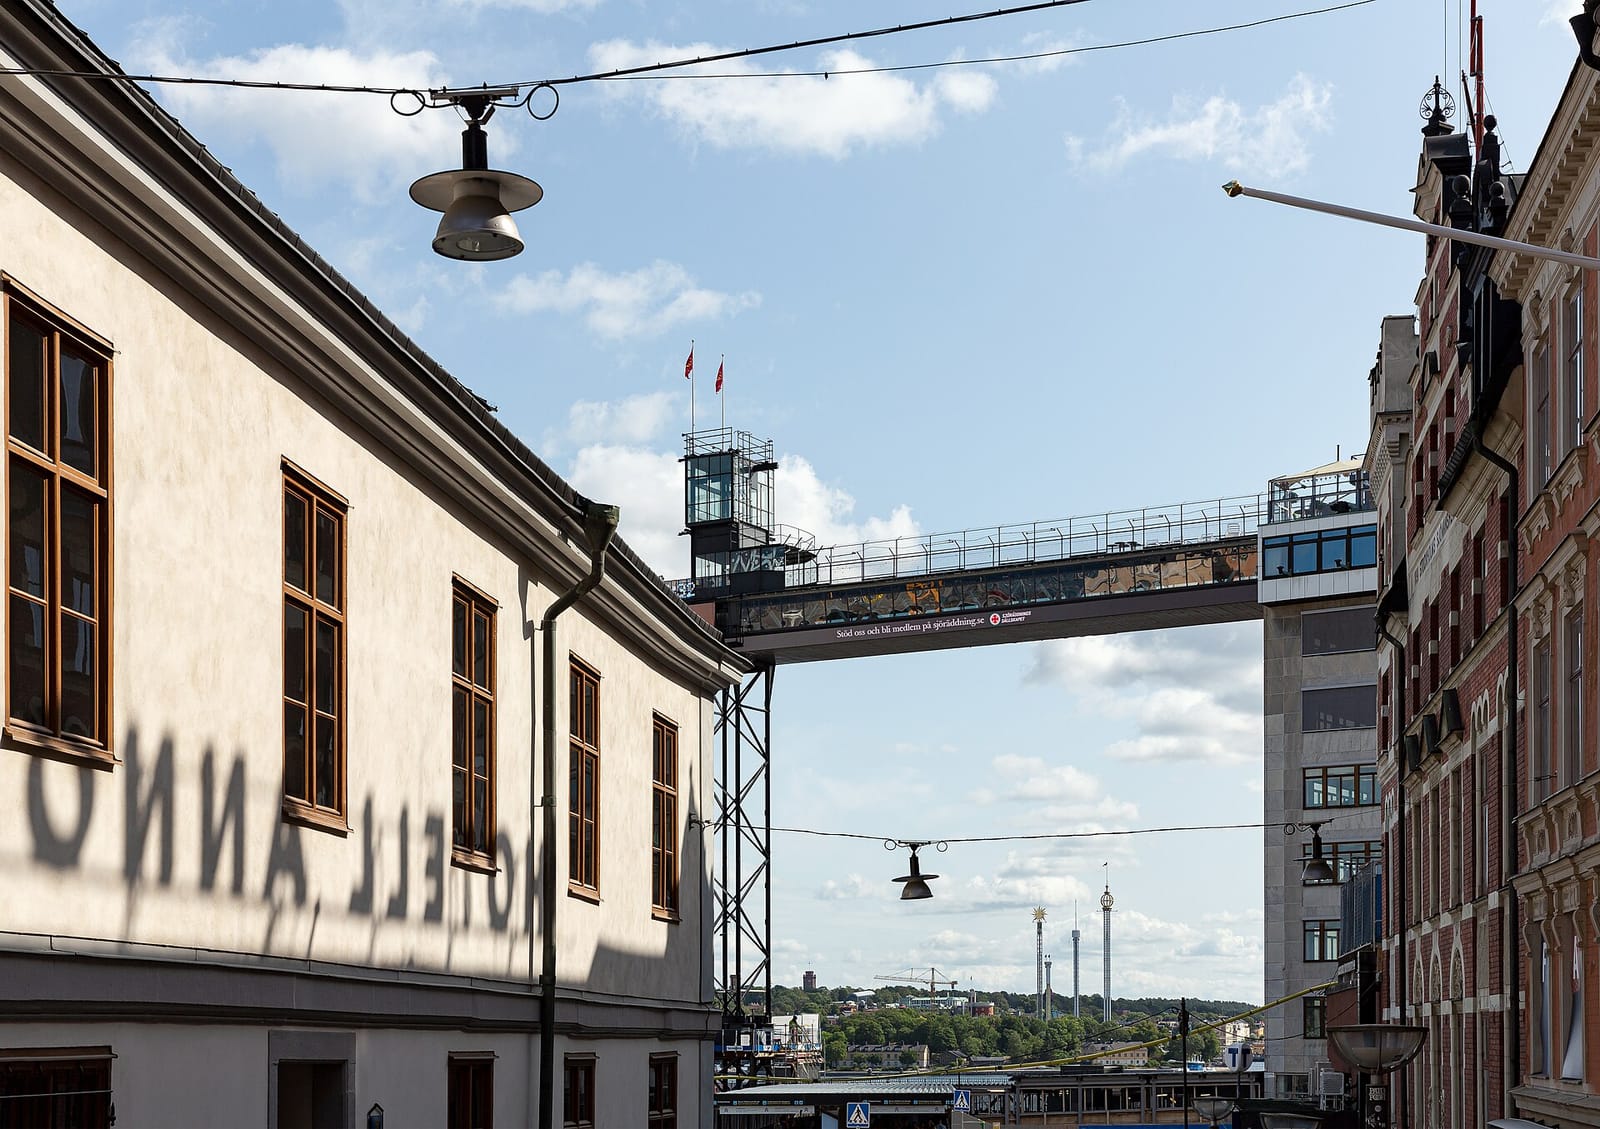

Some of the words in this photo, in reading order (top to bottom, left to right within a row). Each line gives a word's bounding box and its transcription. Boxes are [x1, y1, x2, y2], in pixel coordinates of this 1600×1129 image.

[836, 628, 853, 638] Stöd
[867, 626, 880, 635] och
[881, 625, 891, 634] bli
[892, 623, 921, 632] medlem
[922, 621, 932, 632] på
[933, 617, 985, 632] sjöräddning.se
[1228, 1047, 1239, 1067] T
[1242, 1048, 1250, 1067] T
